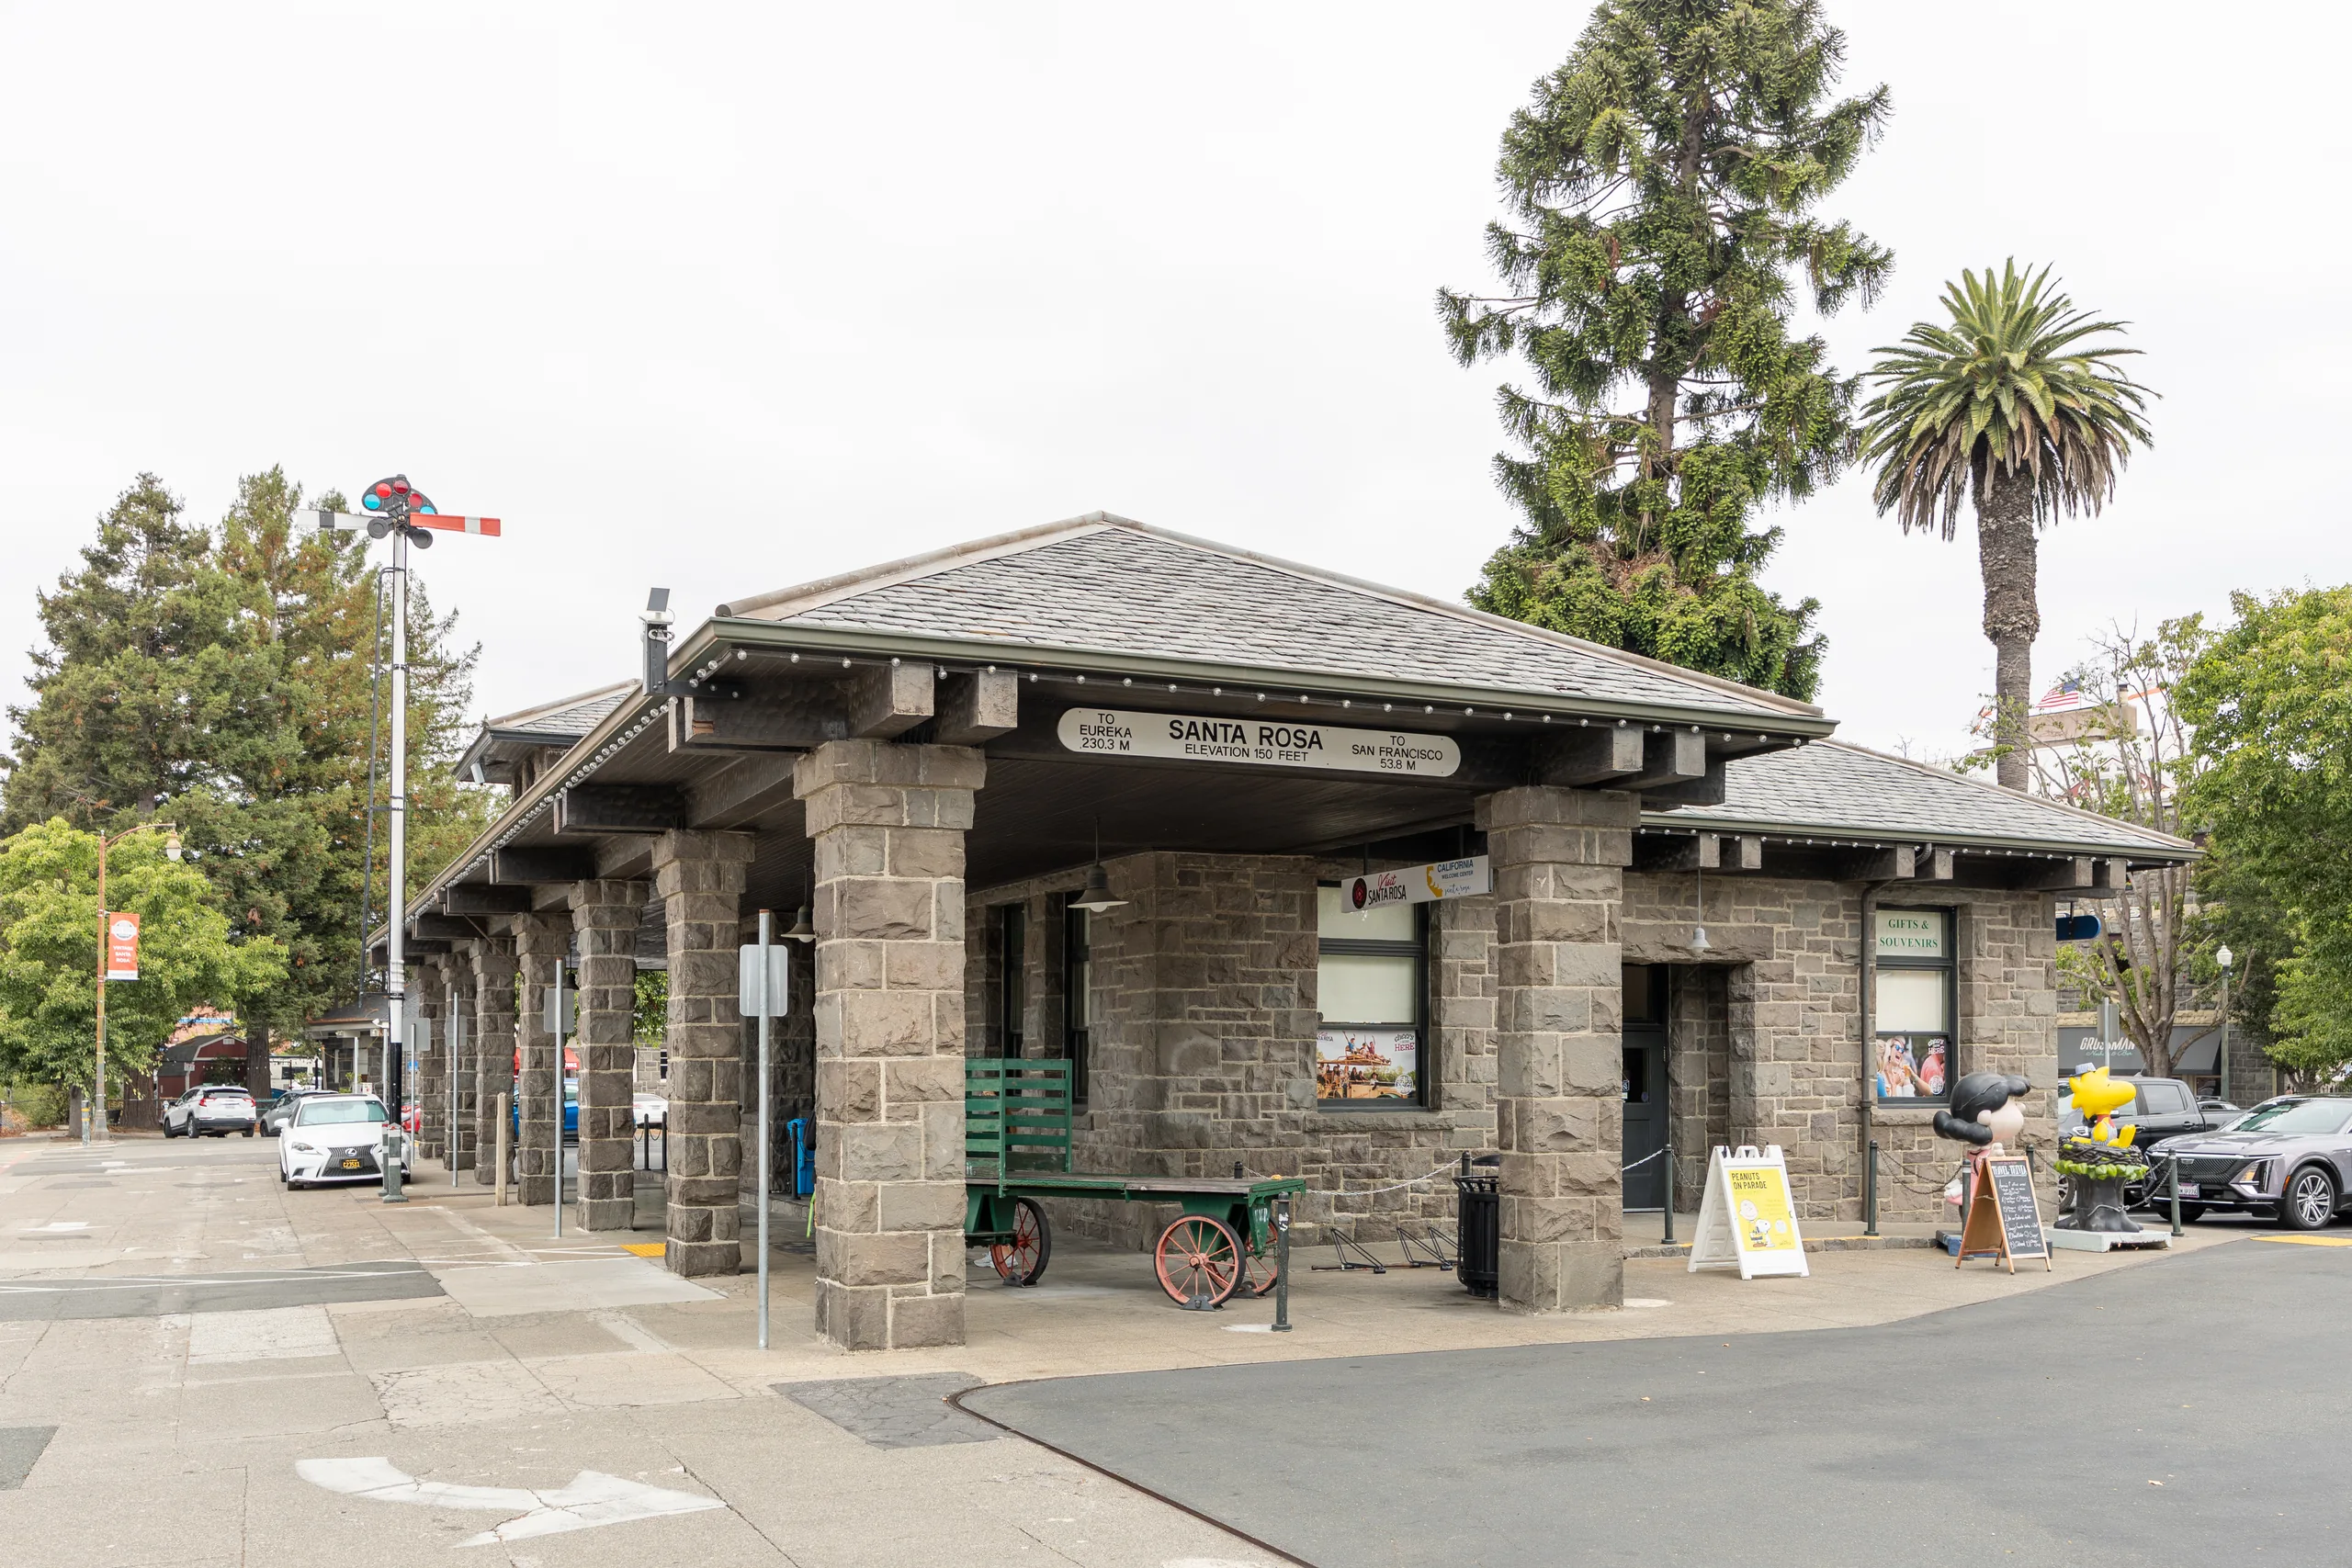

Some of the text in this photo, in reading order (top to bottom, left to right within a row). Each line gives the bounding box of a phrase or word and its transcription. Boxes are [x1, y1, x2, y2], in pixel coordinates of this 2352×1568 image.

[1098, 714, 1114, 724] TO
[1080, 725, 1132, 738] EUREKA
[1169, 719, 1324, 750] SANTA ROSA
[1082, 738, 1130, 750] 230.3 M
[1390, 735, 1406, 746] TO
[1185, 743, 1308, 762] ELEVATION 150 FEET
[1351, 744, 1443, 761] SAN FRANCISCO
[1380, 759, 1416, 771] 53.8 M
[1437, 859, 1474, 873] CALIFORNIA
[1442, 872, 1460, 880] WELCOME
[1378, 873, 1397, 892] Visit
[1368, 885, 1407, 906] SANTA ROSA
[1888, 919, 1929, 930] GIFTS &
[1880, 937, 1938, 948] SOUVENIRS
[1394, 1042, 1415, 1052] HERE
[1731, 1172, 1760, 1181] PEANUTS
[1733, 1180, 1768, 1190] ON PARADE
